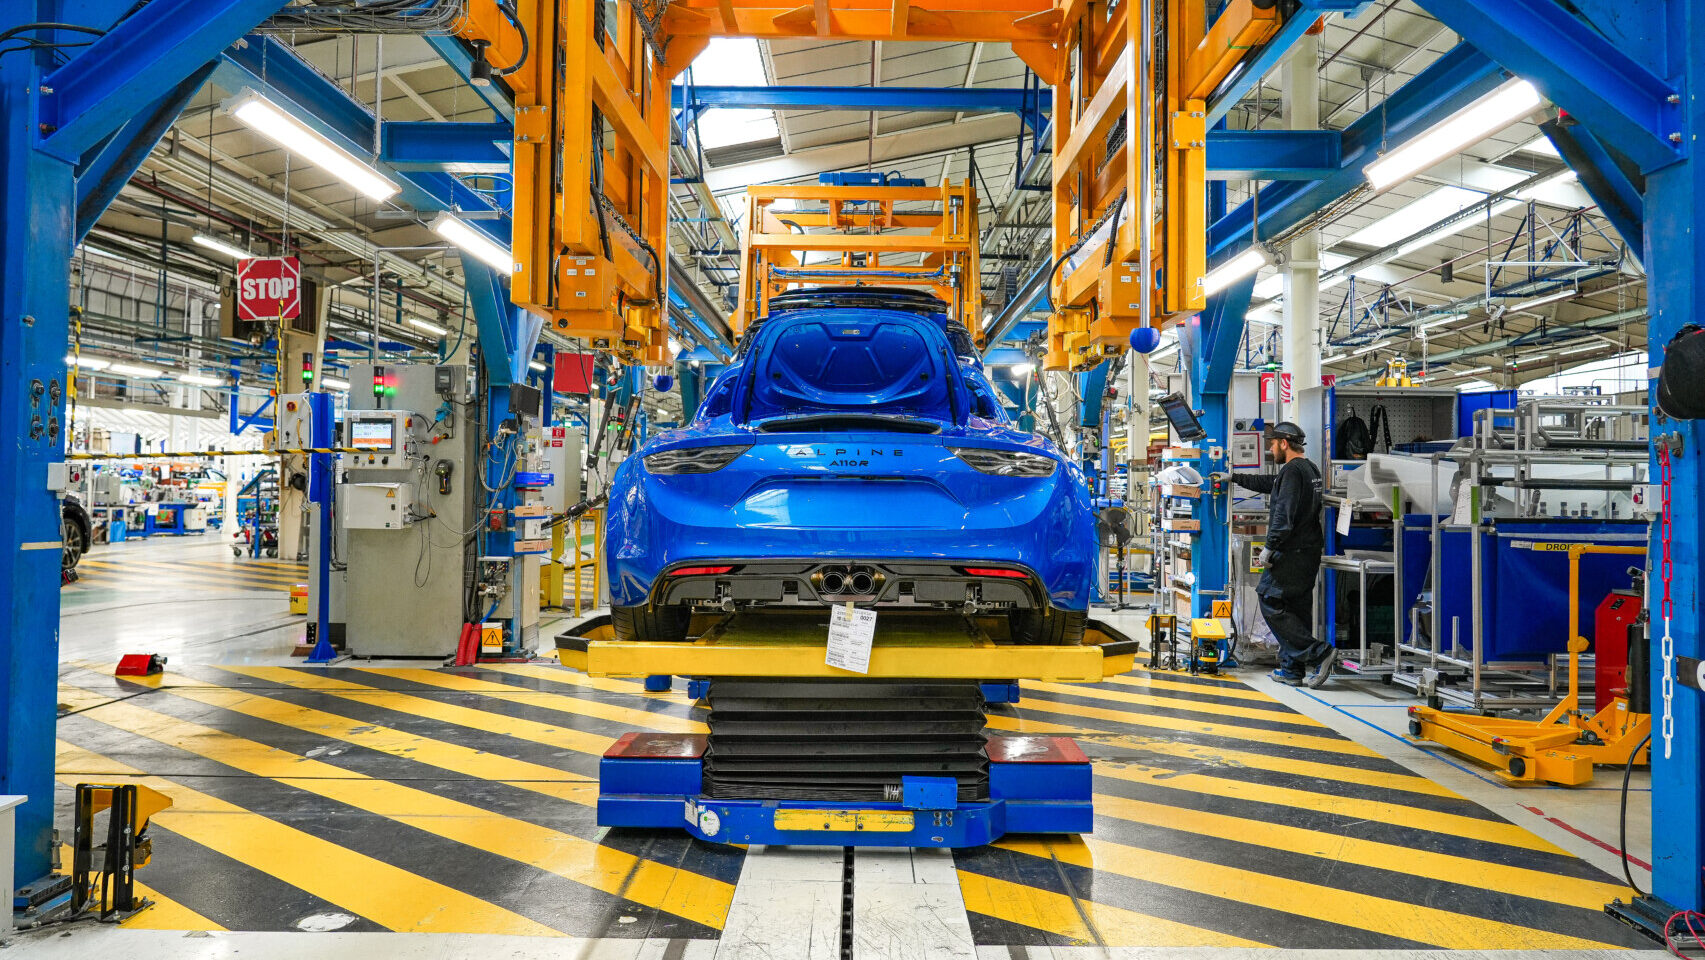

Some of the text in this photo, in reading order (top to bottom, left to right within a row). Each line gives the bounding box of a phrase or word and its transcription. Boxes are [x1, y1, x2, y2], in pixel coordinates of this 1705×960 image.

[243, 277, 295, 300] STOP
[795, 448, 904, 456] ALPINE
[1545, 543, 1574, 551] DROI
